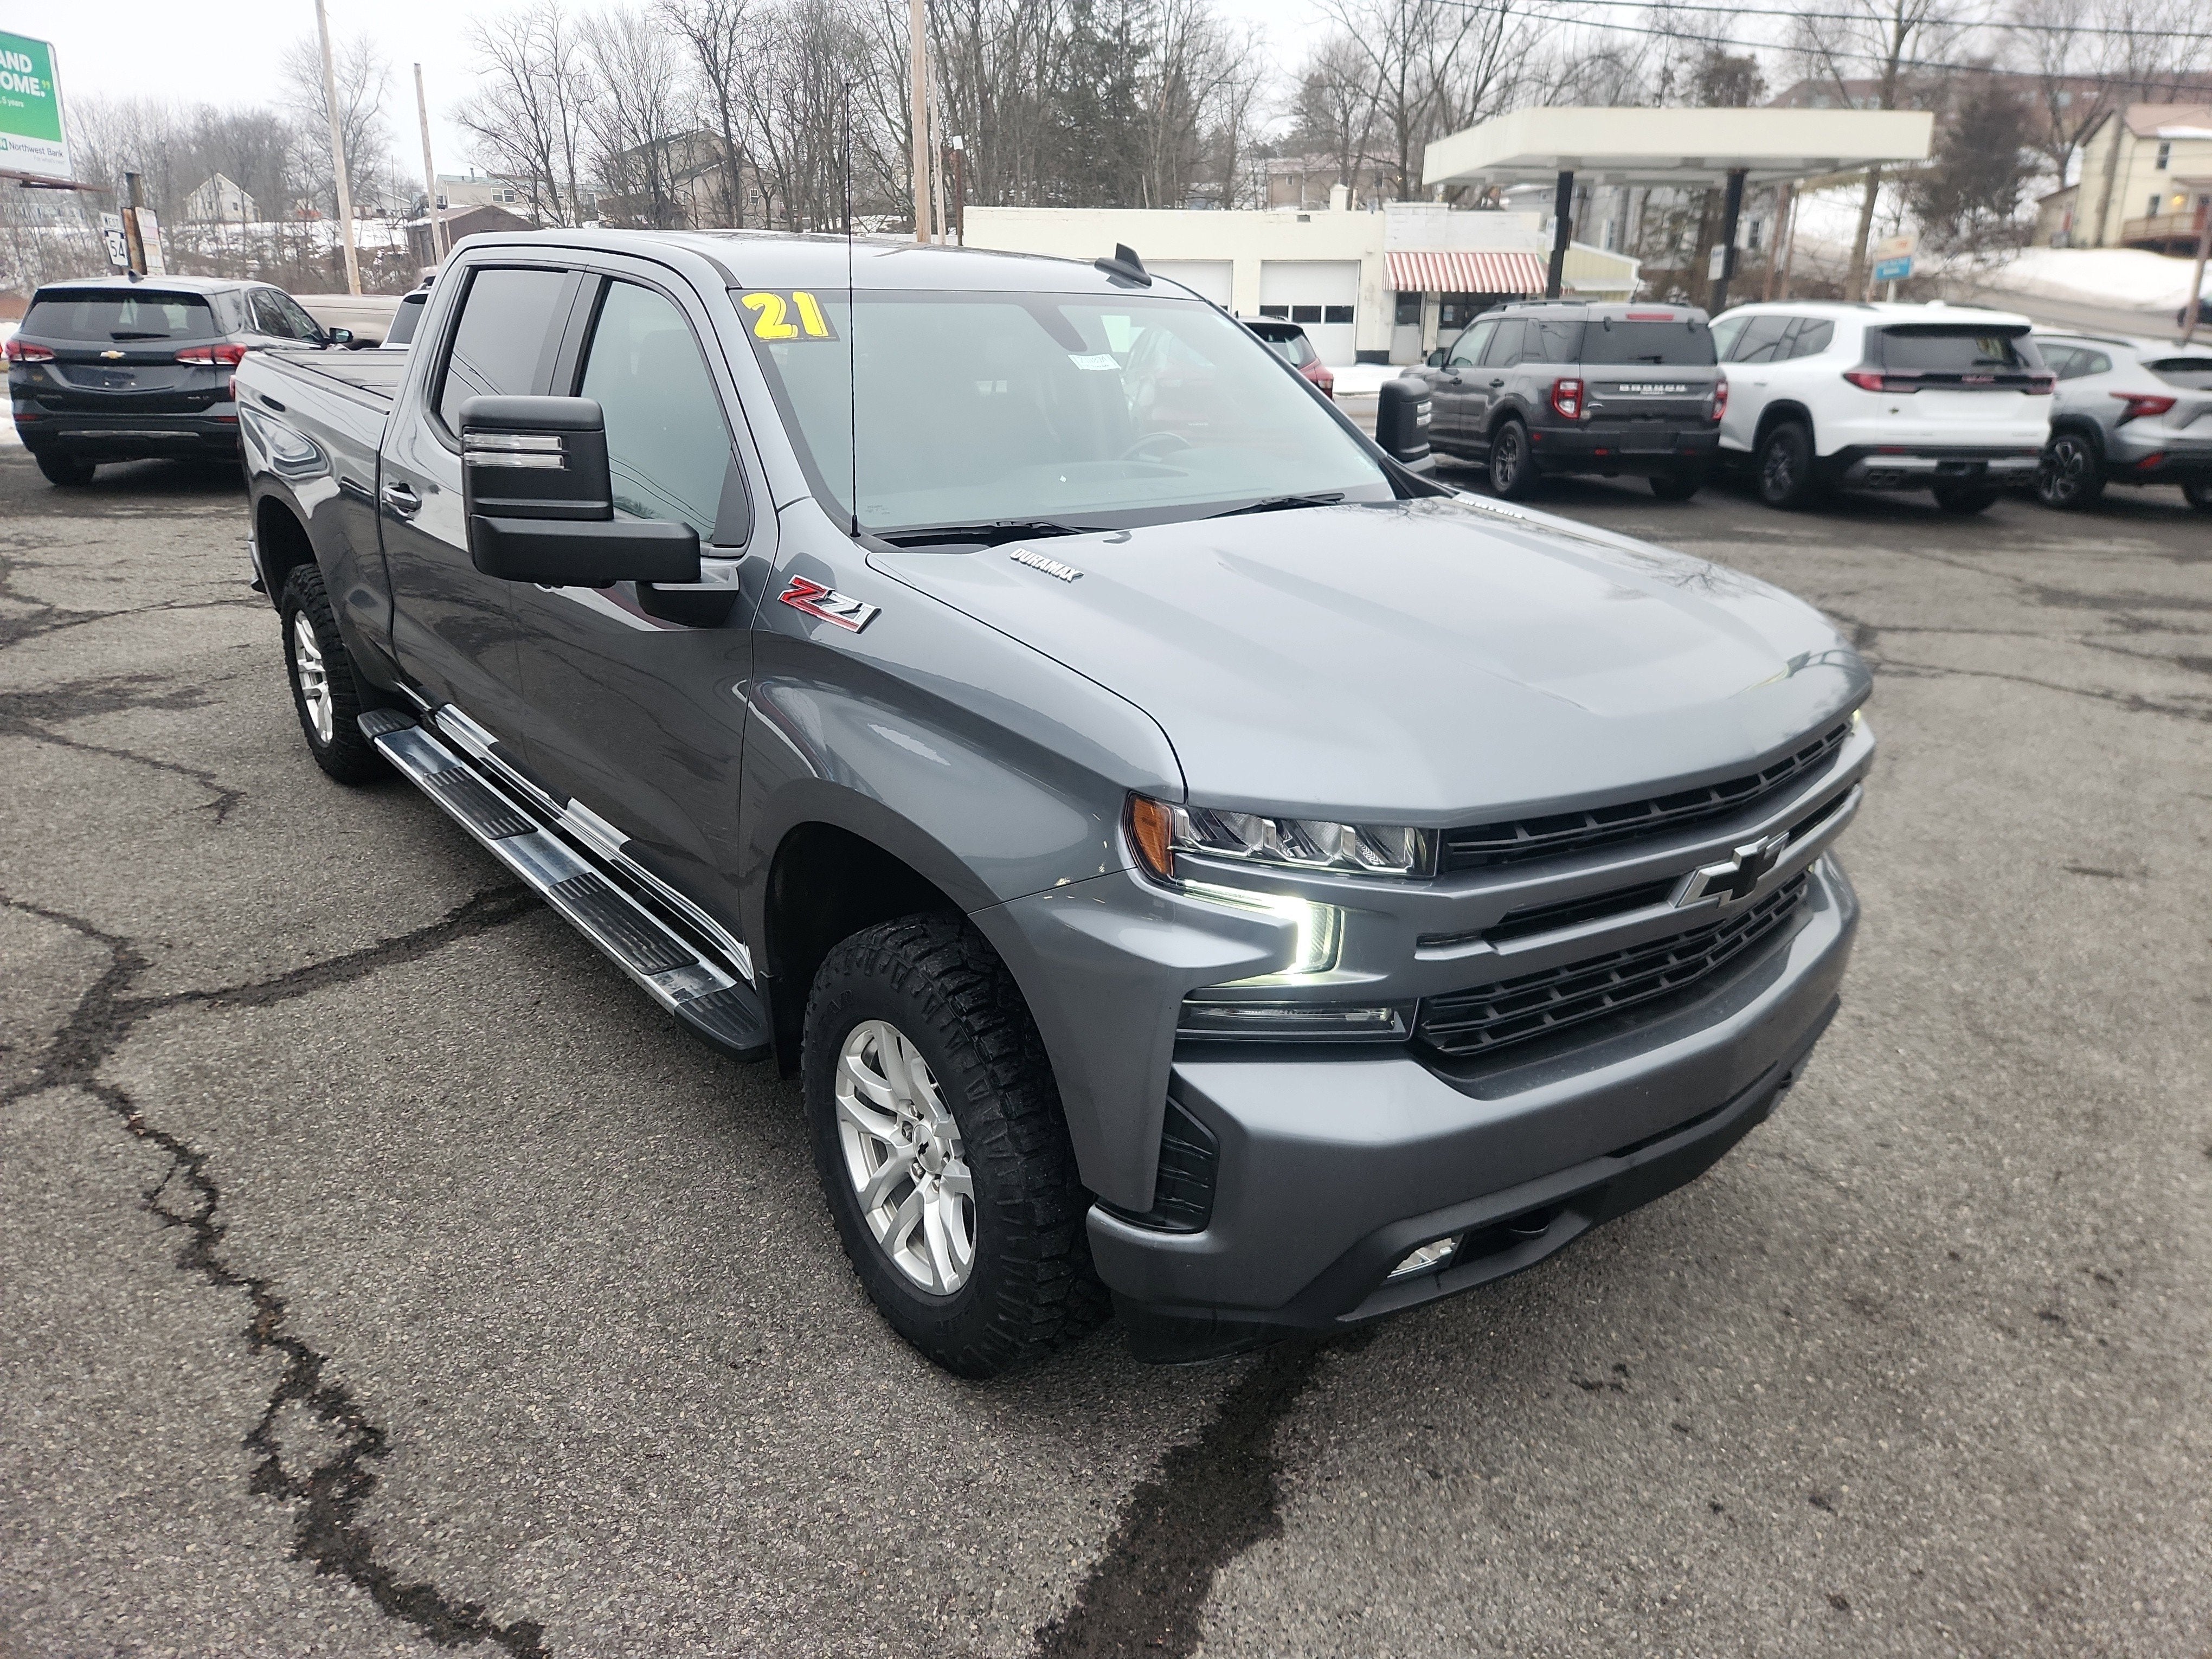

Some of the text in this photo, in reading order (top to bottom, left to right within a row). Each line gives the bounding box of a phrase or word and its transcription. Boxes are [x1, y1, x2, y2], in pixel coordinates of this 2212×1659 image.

[9, 141, 63, 158] Northwest Bank
[105, 216, 118, 227] WEST
[110, 240, 125, 259] 54
[741, 291, 828, 339] 21
[1009, 547, 1084, 583] DURAMAX
[777, 574, 883, 634] Z71
